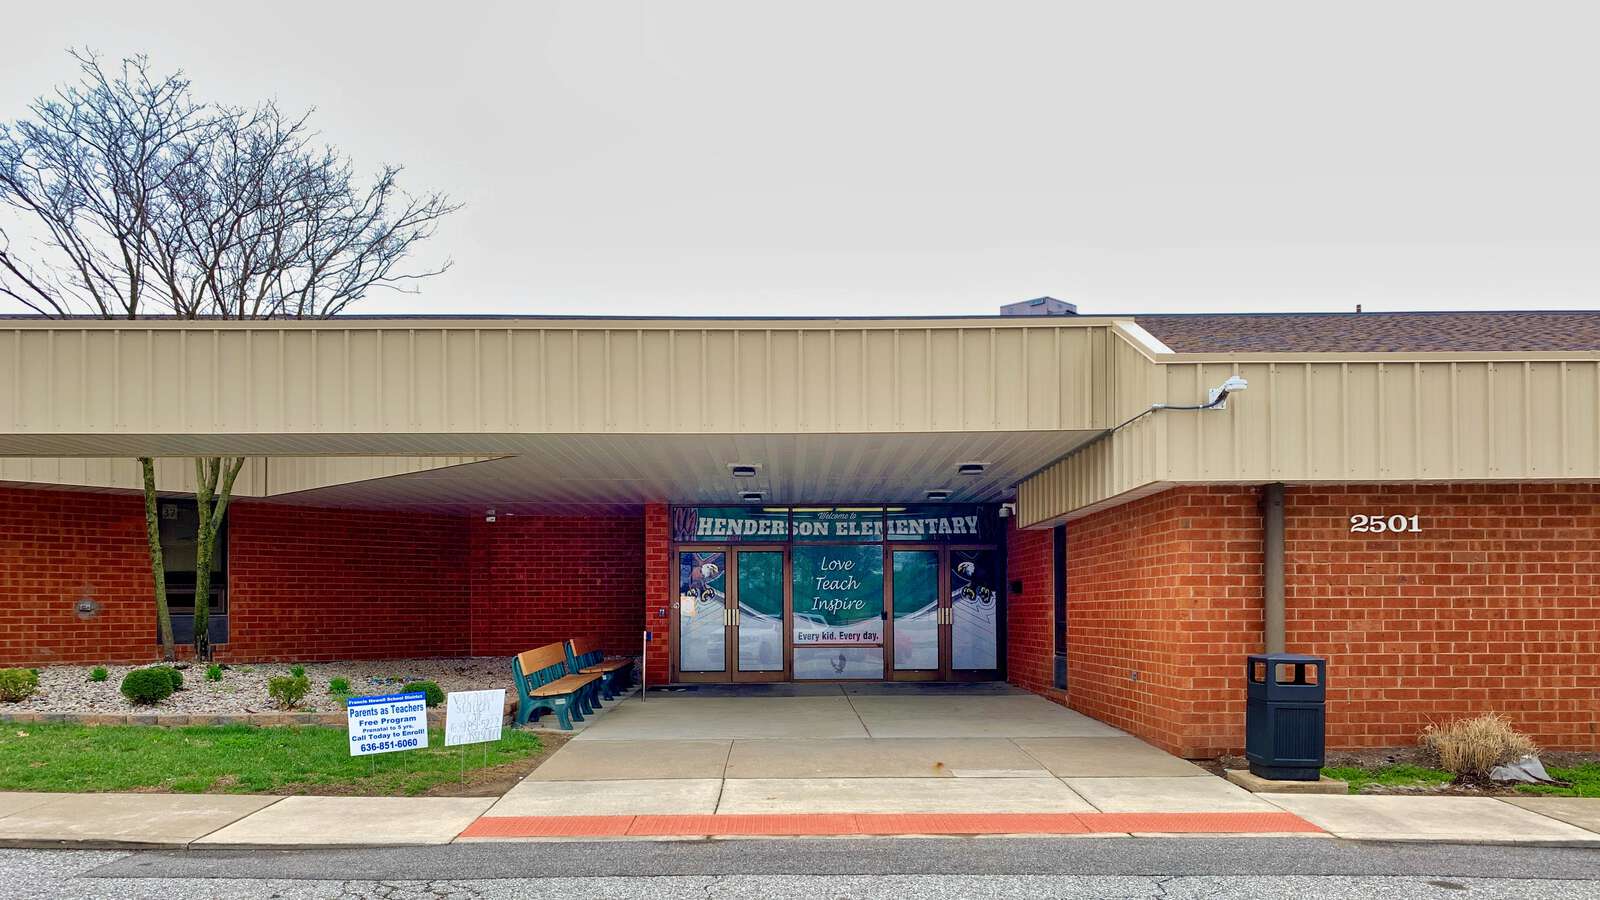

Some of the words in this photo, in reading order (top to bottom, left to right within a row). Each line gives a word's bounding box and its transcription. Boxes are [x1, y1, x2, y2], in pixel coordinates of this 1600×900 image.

[817, 511, 849, 520] Welcome
[849, 512, 857, 520] to
[697, 517, 829, 536] HENDERSON
[836, 515, 978, 536] ELEMENTARY
[1350, 514, 1423, 533] 2501
[821, 556, 856, 571] Love
[816, 575, 861, 591] Teach
[811, 596, 866, 615] Inspire
[798, 631, 820, 642] Every
[821, 631, 837, 641] kid.
[839, 631, 861, 642] Every
[862, 631, 879, 642] day.
[349, 707, 378, 718] Parents
[391, 704, 424, 714] Teachers
[381, 716, 417, 725] Program
[402, 729, 425, 737] Enroll!
[360, 738, 418, 752] 636-851-6060
